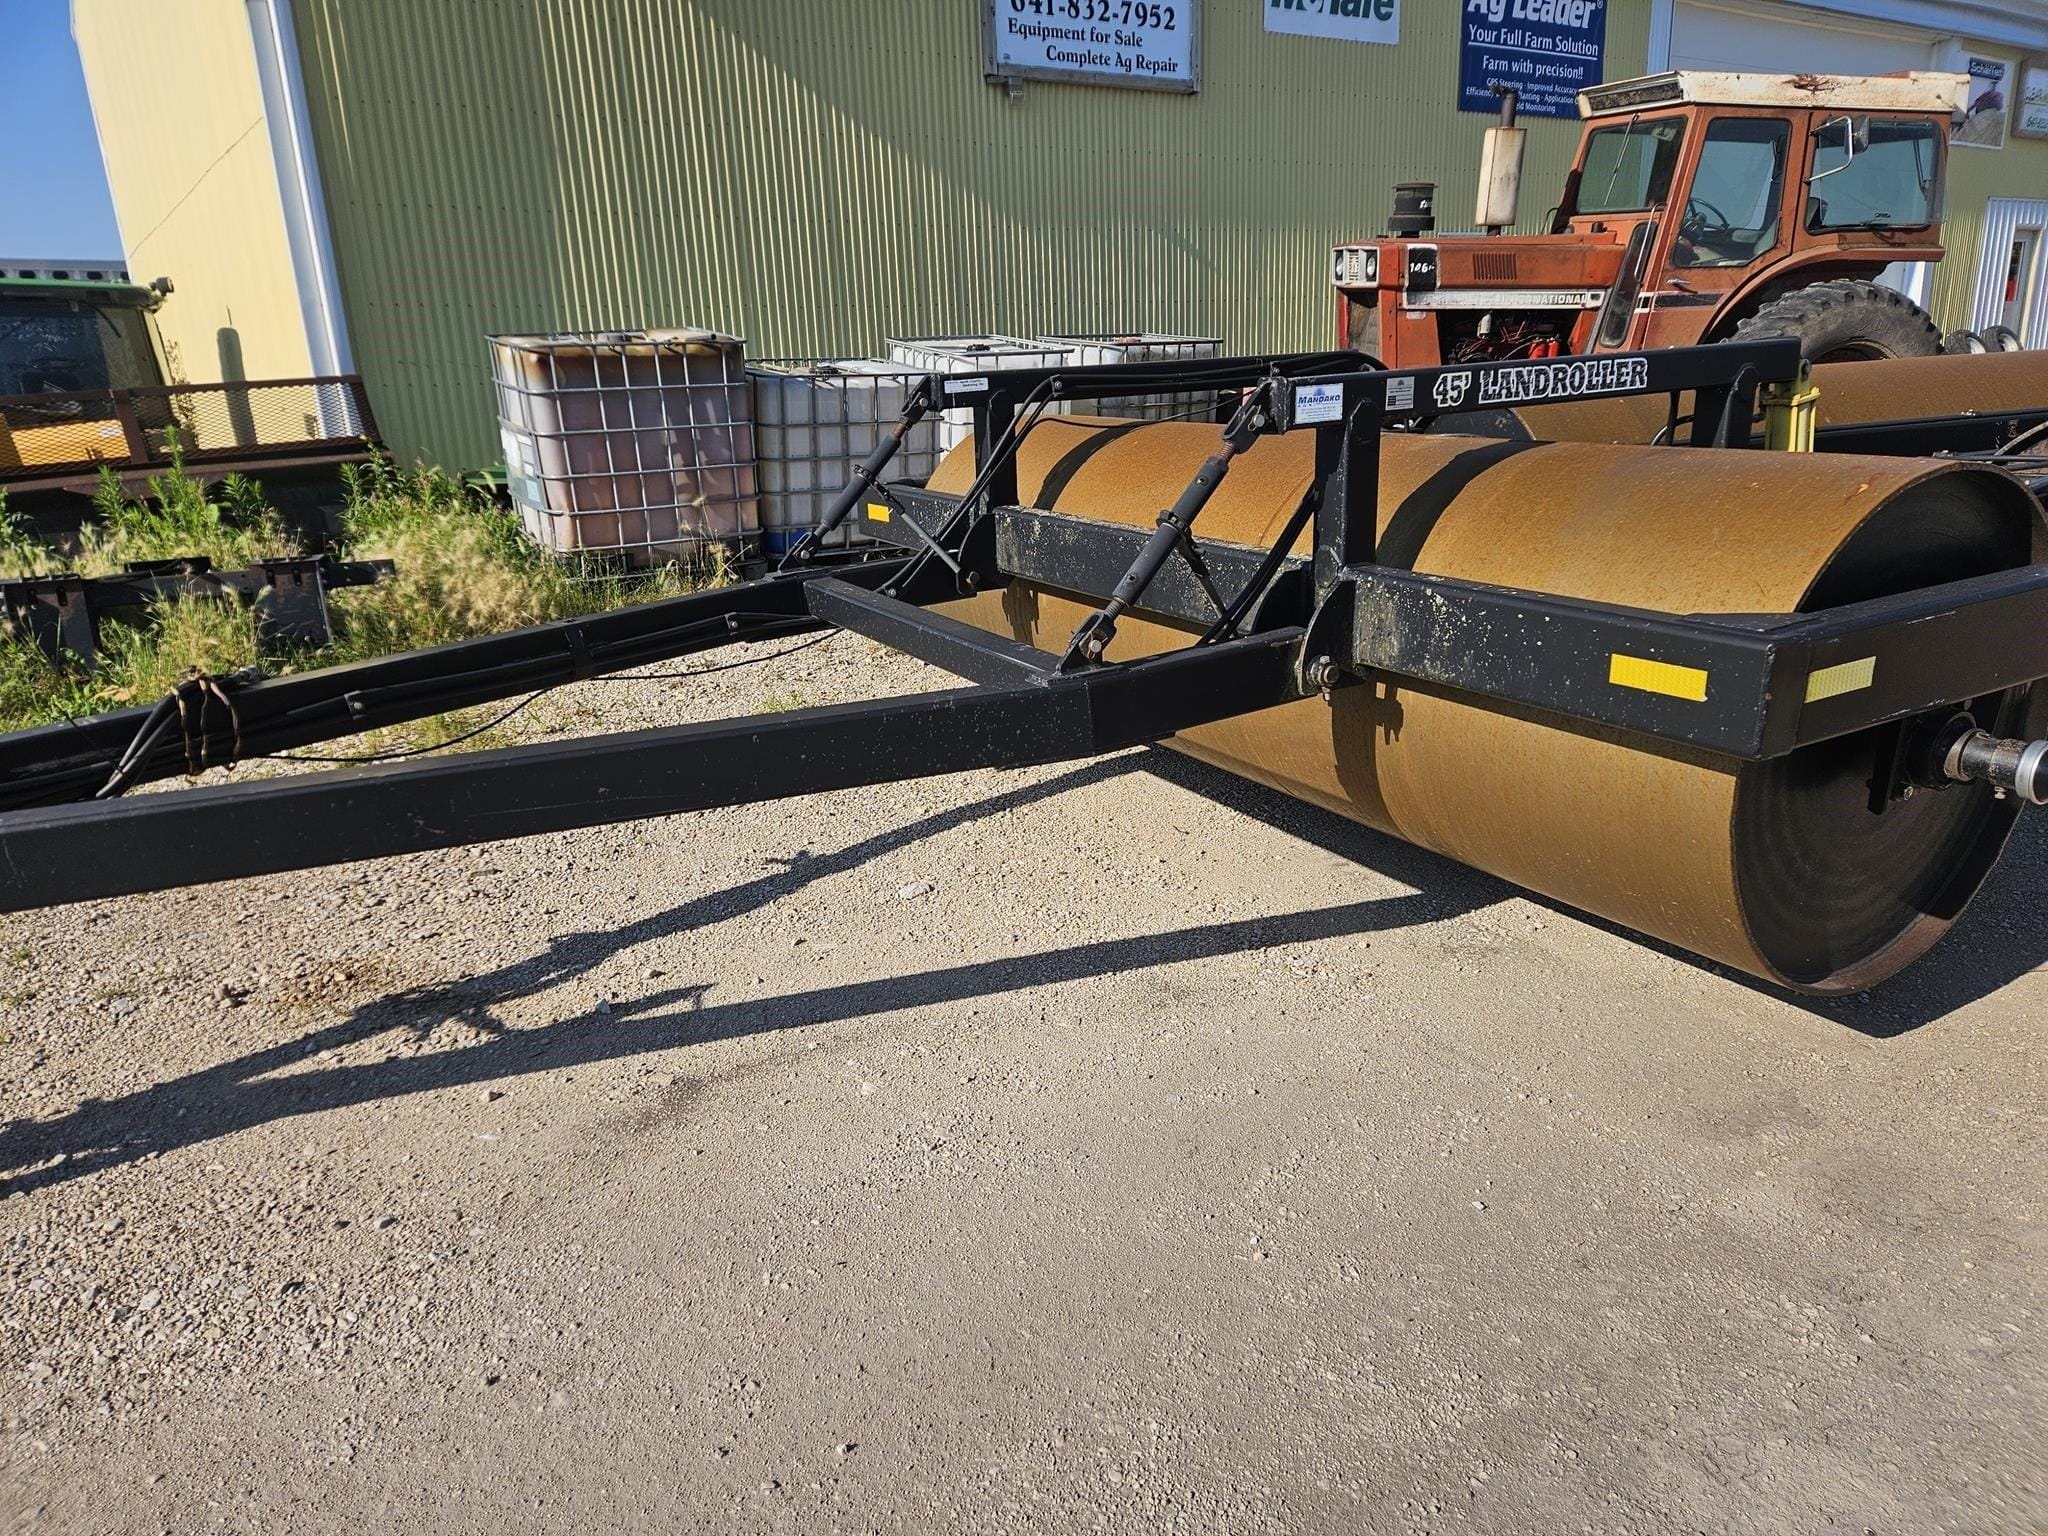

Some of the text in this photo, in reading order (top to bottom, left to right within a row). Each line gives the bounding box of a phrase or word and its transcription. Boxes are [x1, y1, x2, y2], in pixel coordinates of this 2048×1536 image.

[1271, 0, 1394, 21] ale
[1008, 17, 1143, 48] Equipment for Sale
[1468, 24, 1599, 57] Your Full Farm Solution
[1046, 45, 1178, 74] Complete Ag Repair
[1482, 55, 1584, 80] Farm with precision!!
[1486, 77, 1577, 96] GPS Steering Improved Accuracy
[1525, 102, 1556, 114] Monitoring
[1544, 94, 1573, 105] Application
[1433, 357, 1648, 408] 45' LANDROLLER
[1298, 393, 1341, 405] MANDAKO
